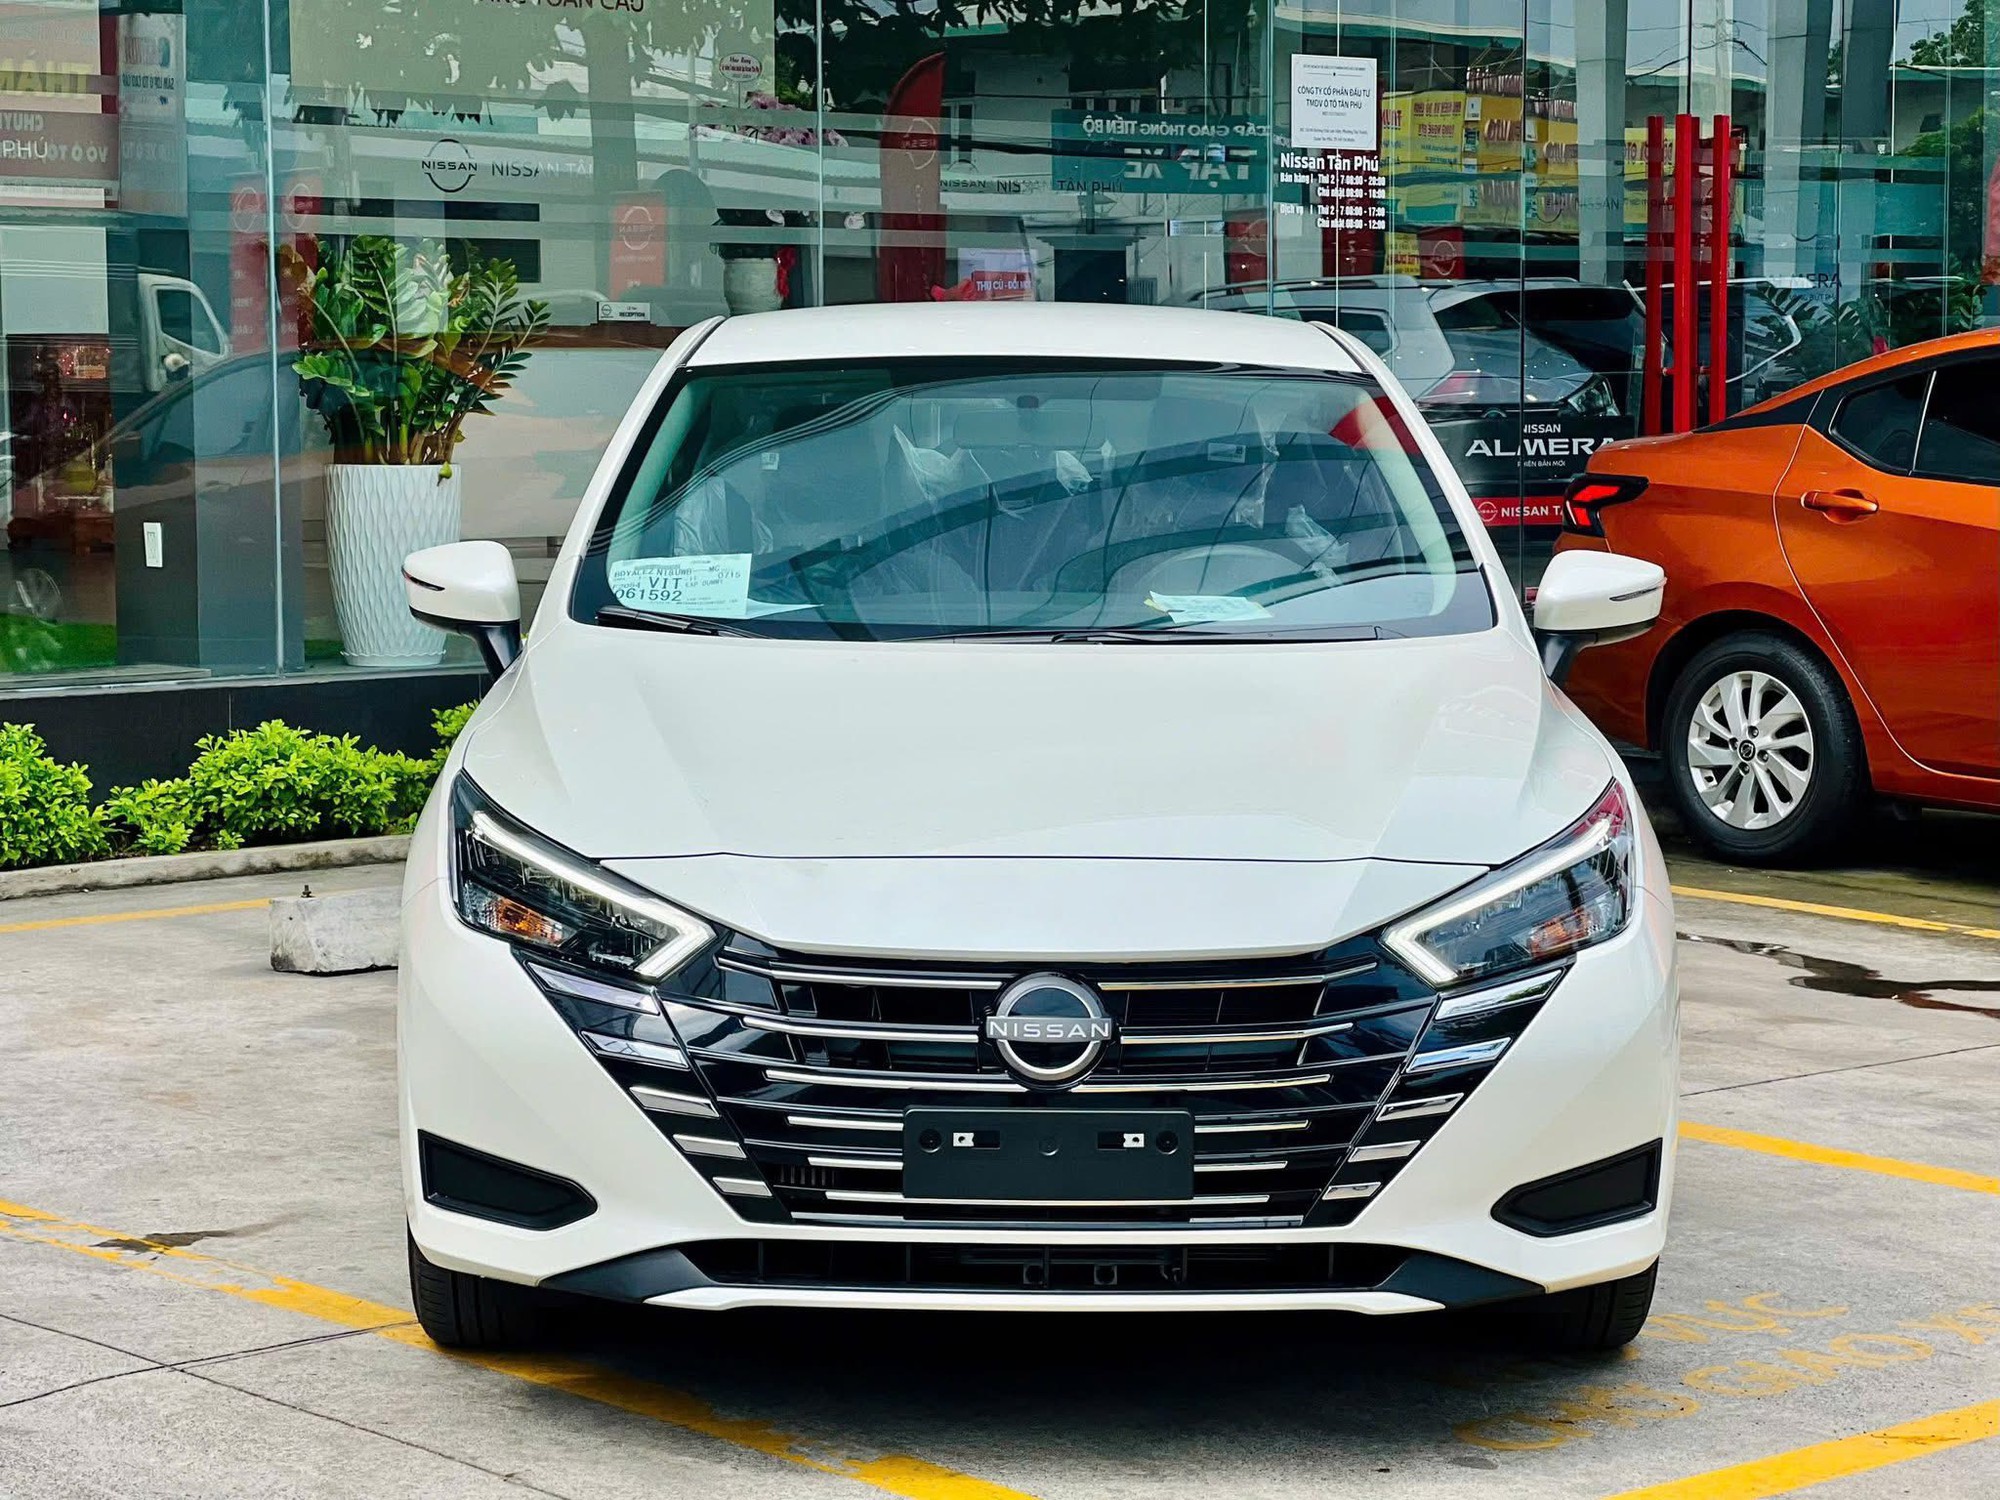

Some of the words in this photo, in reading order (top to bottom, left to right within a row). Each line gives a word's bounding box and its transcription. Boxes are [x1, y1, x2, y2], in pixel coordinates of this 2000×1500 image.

[2, 136, 48, 158] PHÚ
[422, 161, 478, 172] NISSAN
[1280, 152, 1324, 170] Nissan
[1327, 154, 1351, 170] Tân
[1354, 156, 1378, 172] Phú
[492, 163, 562, 178] NISSAN
[940, 180, 986, 188] NISSAN
[1330, 175, 1335, 184] 2
[1341, 175, 1344, 184] 7
[1330, 206, 1334, 214] 2
[1340, 206, 1344, 215] 7
[1501, 506, 1549, 518] NISSAN
[648, 576, 682, 590] VIT
[614, 588, 682, 602] 061592
[989, 1021, 1109, 1038] NISSAN
